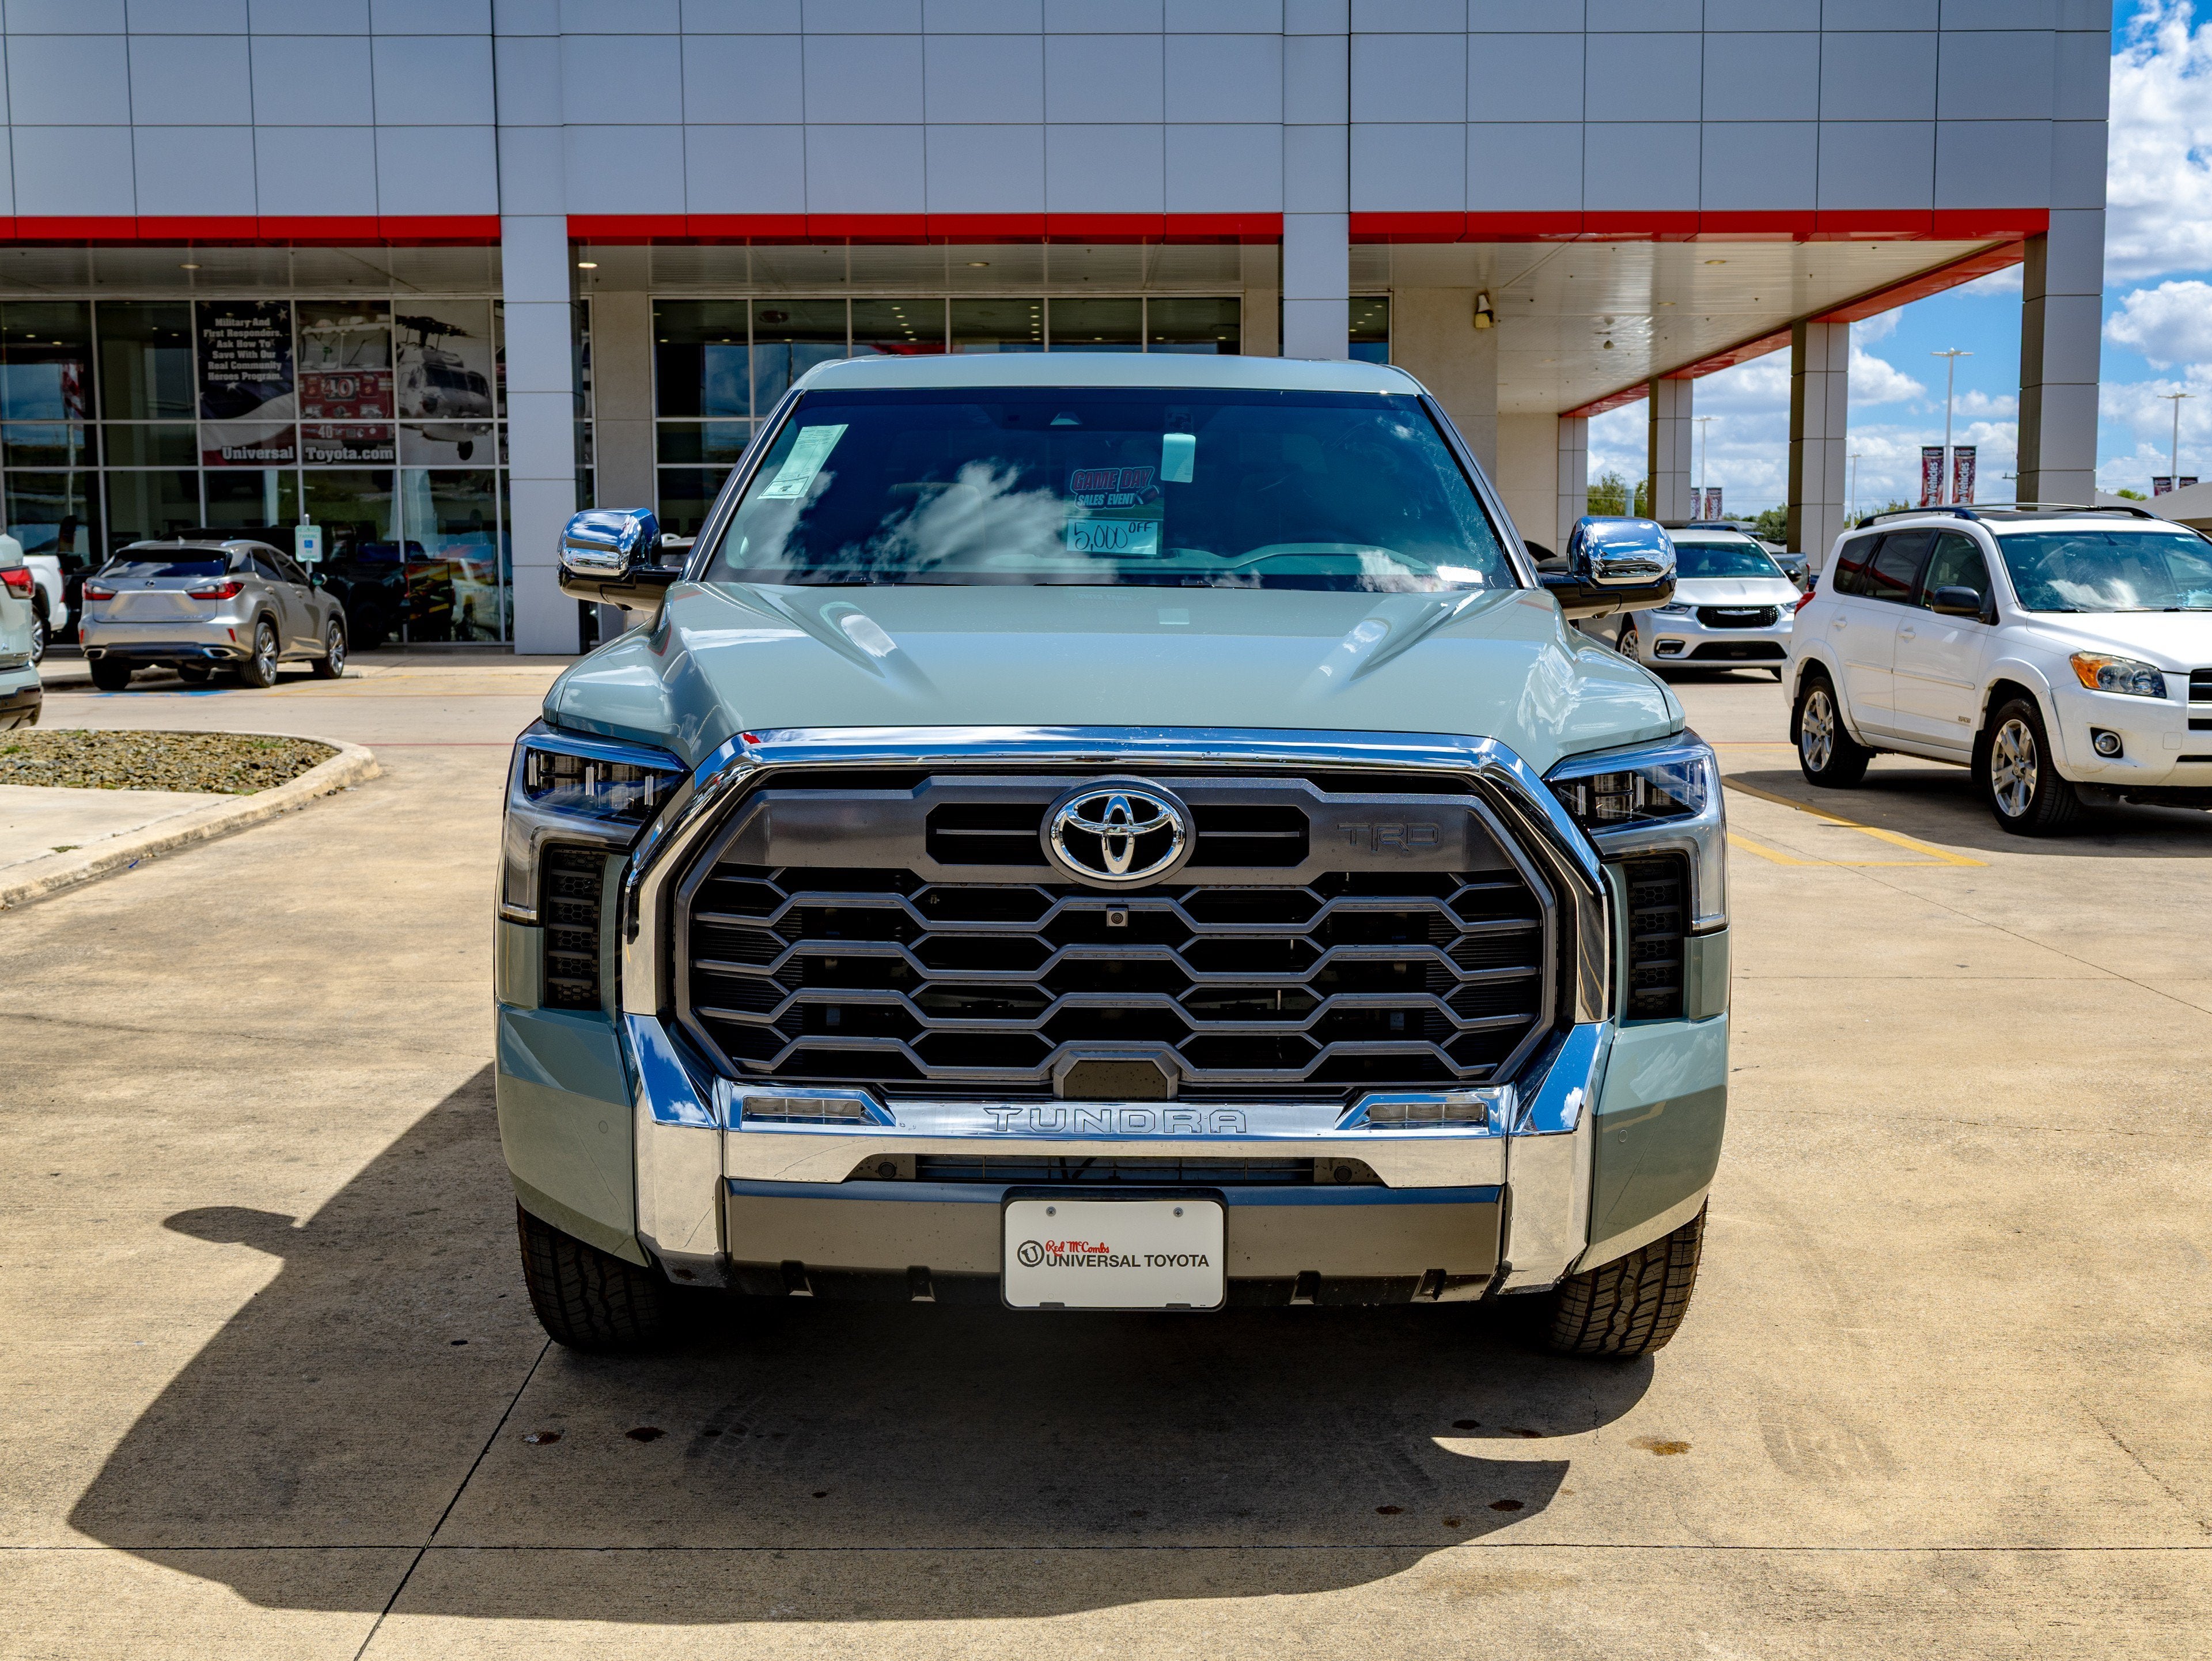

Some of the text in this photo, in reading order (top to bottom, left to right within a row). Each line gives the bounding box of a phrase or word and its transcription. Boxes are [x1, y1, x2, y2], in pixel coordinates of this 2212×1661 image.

[215, 317, 270, 328] Military And
[203, 329, 224, 337] First
[217, 339, 271, 348] Ask How To
[212, 350, 276, 359] Save With Our
[207, 361, 282, 370] Real Community
[208, 372, 283, 382] Heroes Program.
[323, 379, 354, 398] 40
[318, 425, 333, 438] 40
[221, 445, 394, 464] Universal Toyota.com
[1073, 468, 1152, 490] GAME DAY
[1927, 461, 1938, 494] Vehicles
[1959, 462, 1969, 495] Vehicles
[1077, 493, 1137, 506] SALES EVENT
[1074, 521, 1153, 551] 5,000 OFF
[1337, 823, 1439, 853] TRD
[983, 1107, 1247, 1133] TUNDRA
[1046, 1239, 1109, 1257] Red McCombs
[1046, 1254, 1210, 1267] UNIVERSAL TOYOTA
